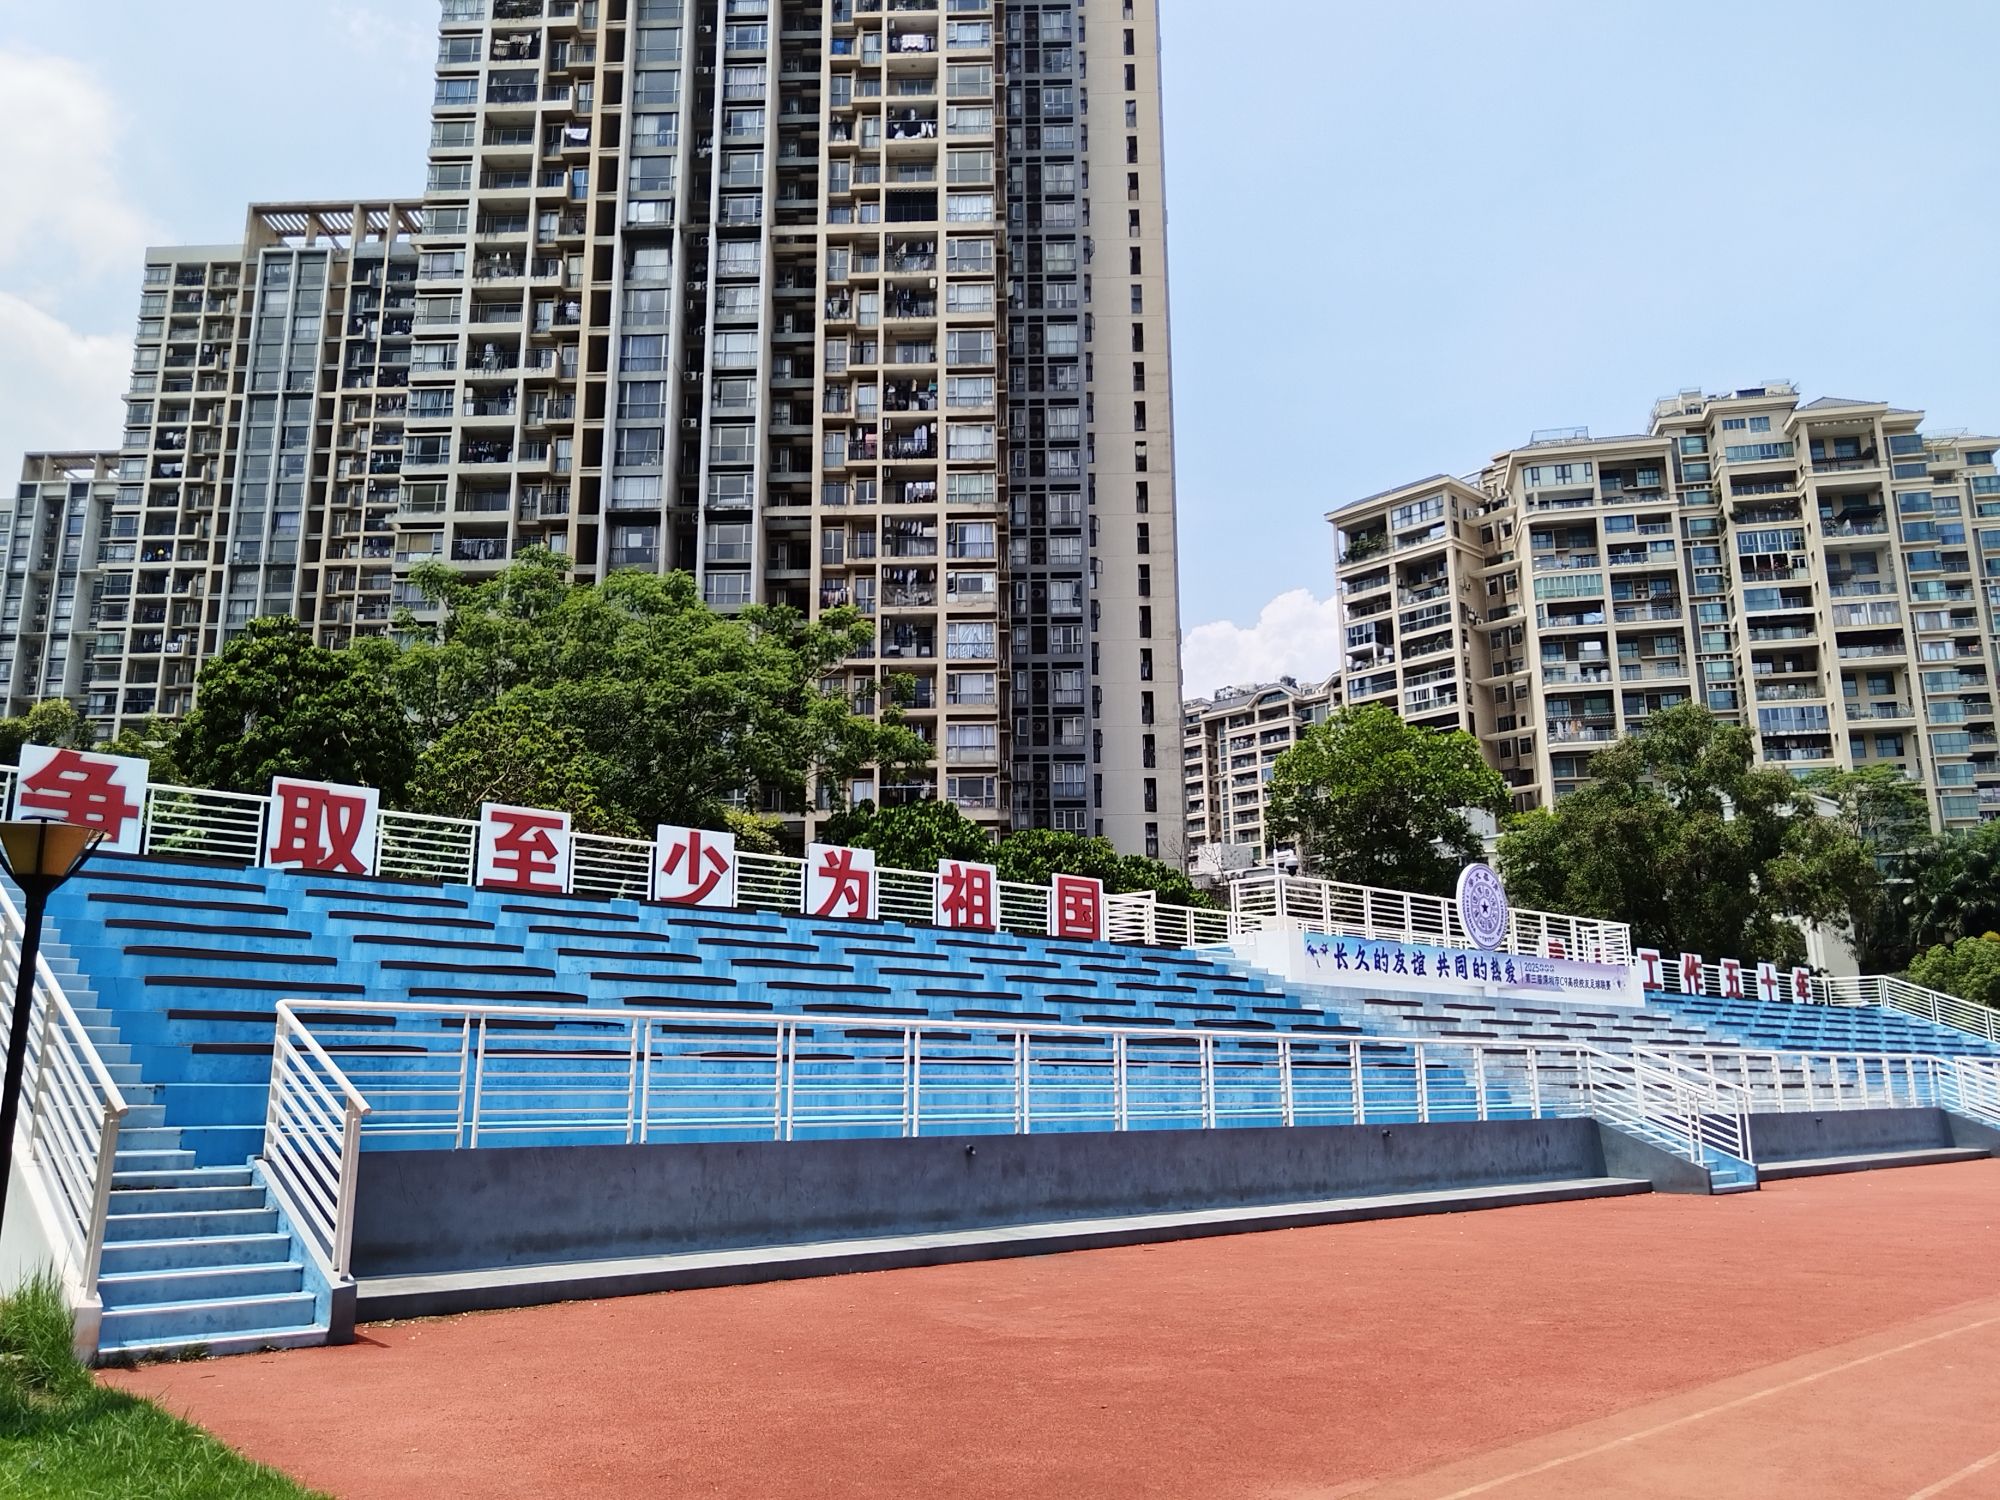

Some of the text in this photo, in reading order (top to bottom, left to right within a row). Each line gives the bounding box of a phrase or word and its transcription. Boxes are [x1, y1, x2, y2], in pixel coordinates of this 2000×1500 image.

[1334, 942, 1518, 985] 长久的友谊 共同的热爱
